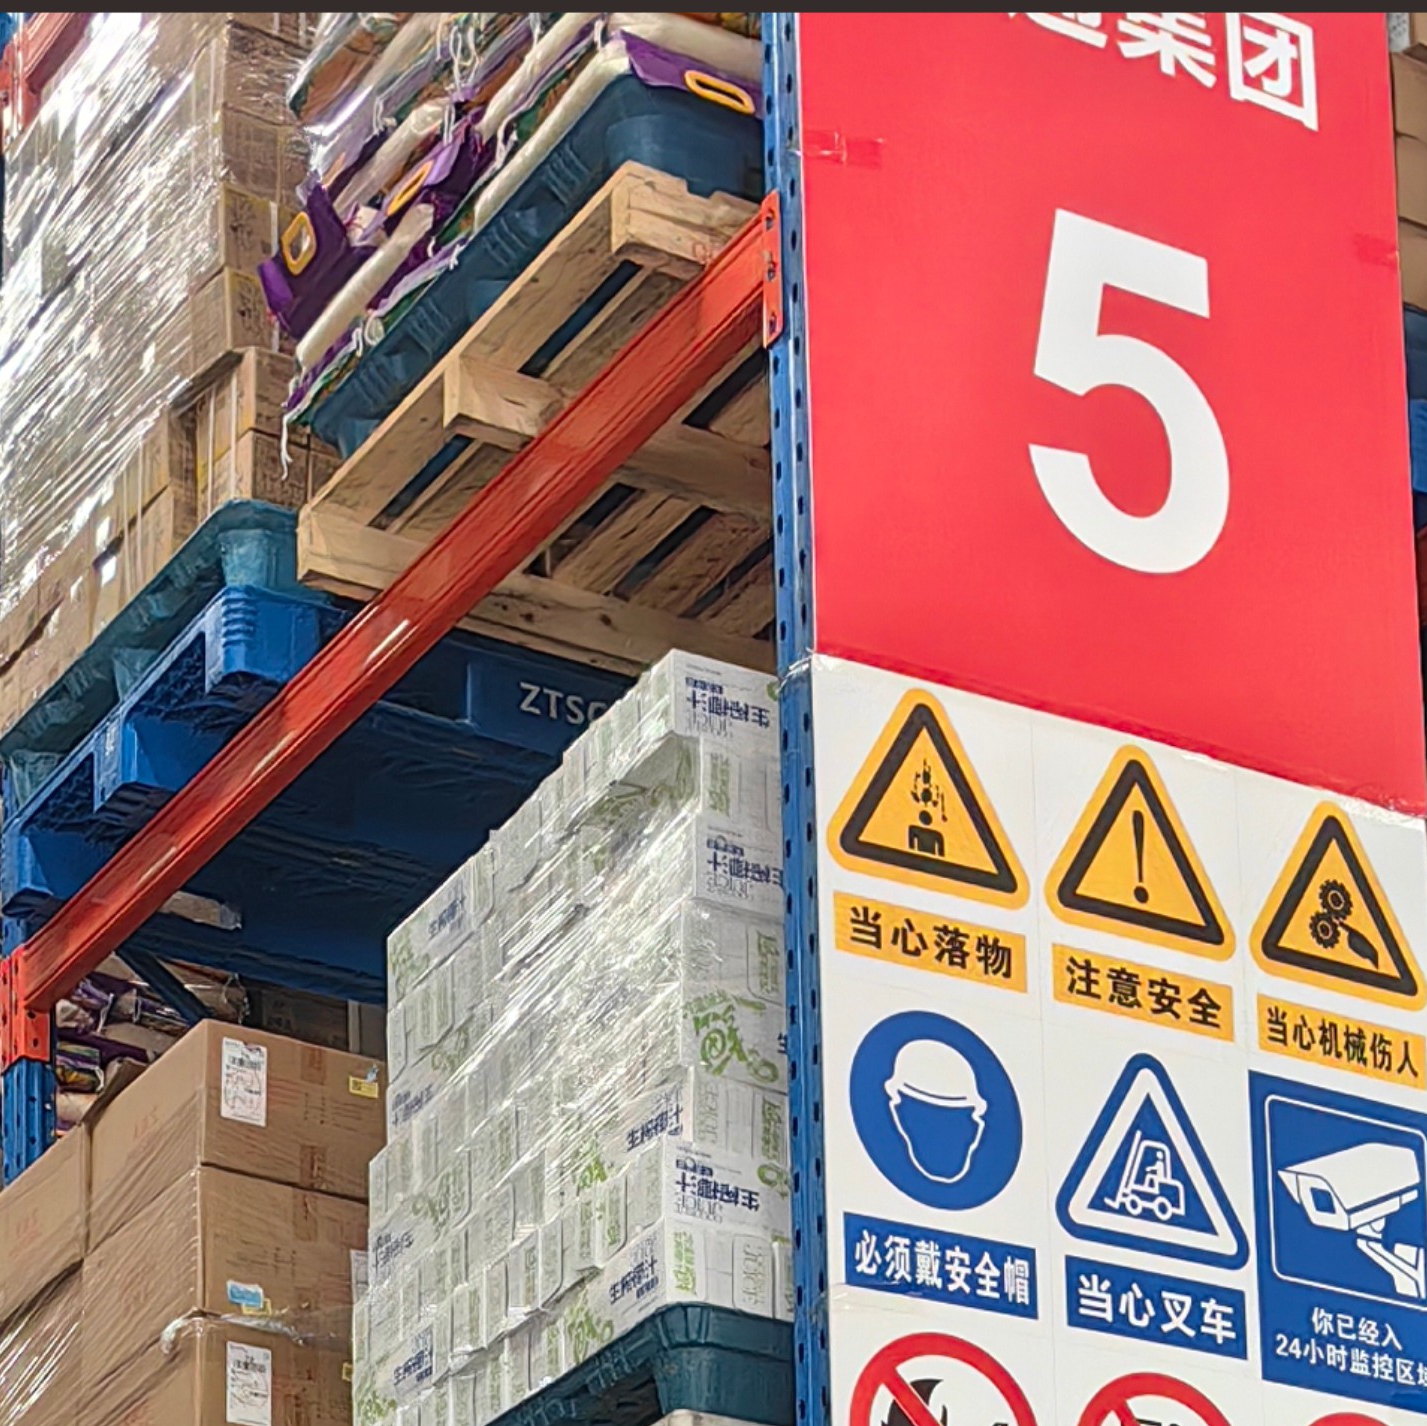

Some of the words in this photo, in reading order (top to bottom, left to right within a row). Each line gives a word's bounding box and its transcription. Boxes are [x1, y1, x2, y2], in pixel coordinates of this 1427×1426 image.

[1008, 13, 1319, 132] 集团
[1028, 208, 1230, 574] 5
[847, 906, 1014, 981] 当心落物
[1065, 957, 1223, 1029] 注意安全
[1265, 1007, 1420, 1078] 当心机械伤人
[853, 1229, 1031, 1306] 必须戴安全帽
[1076, 1272, 1238, 1344] 当心叉车
[1311, 1306, 1403, 1353] 你已经入
